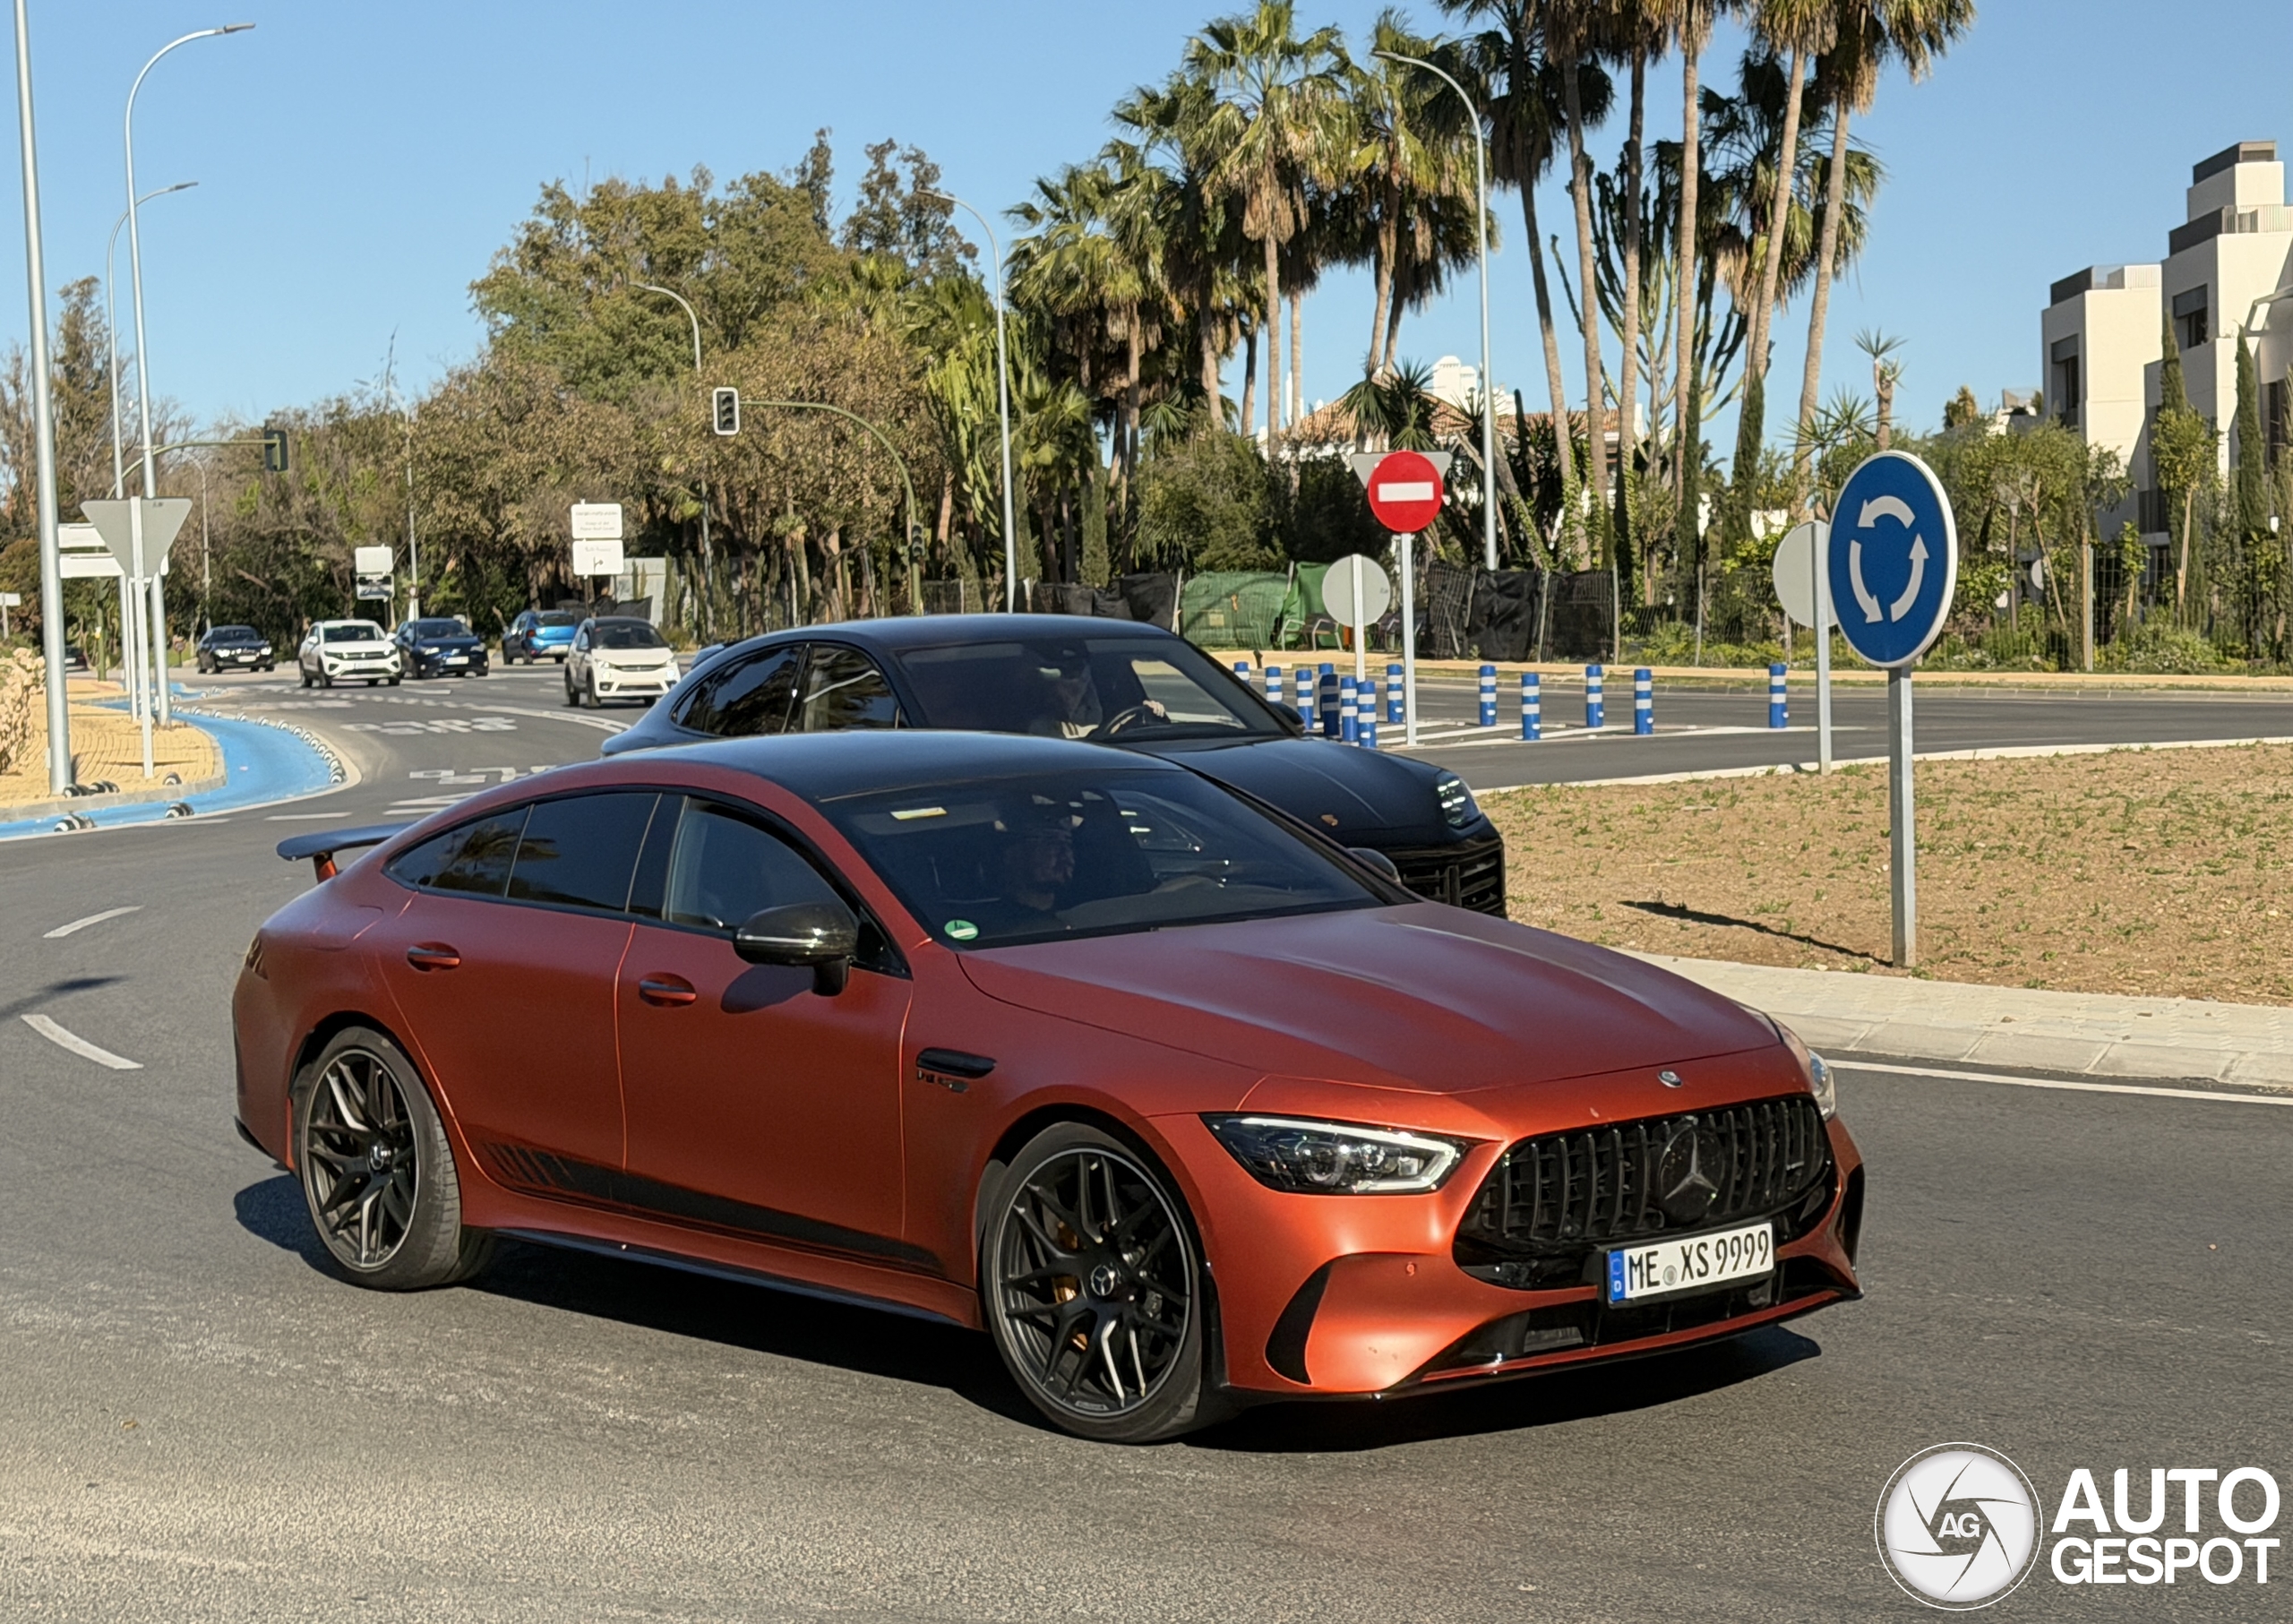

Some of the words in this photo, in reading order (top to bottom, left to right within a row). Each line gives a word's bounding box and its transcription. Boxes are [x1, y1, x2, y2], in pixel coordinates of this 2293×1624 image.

[1627, 1250, 1661, 1291] ME
[1680, 1242, 1709, 1282] XS
[1715, 1230, 1769, 1276] 9999
[1613, 1280, 1622, 1293] D
